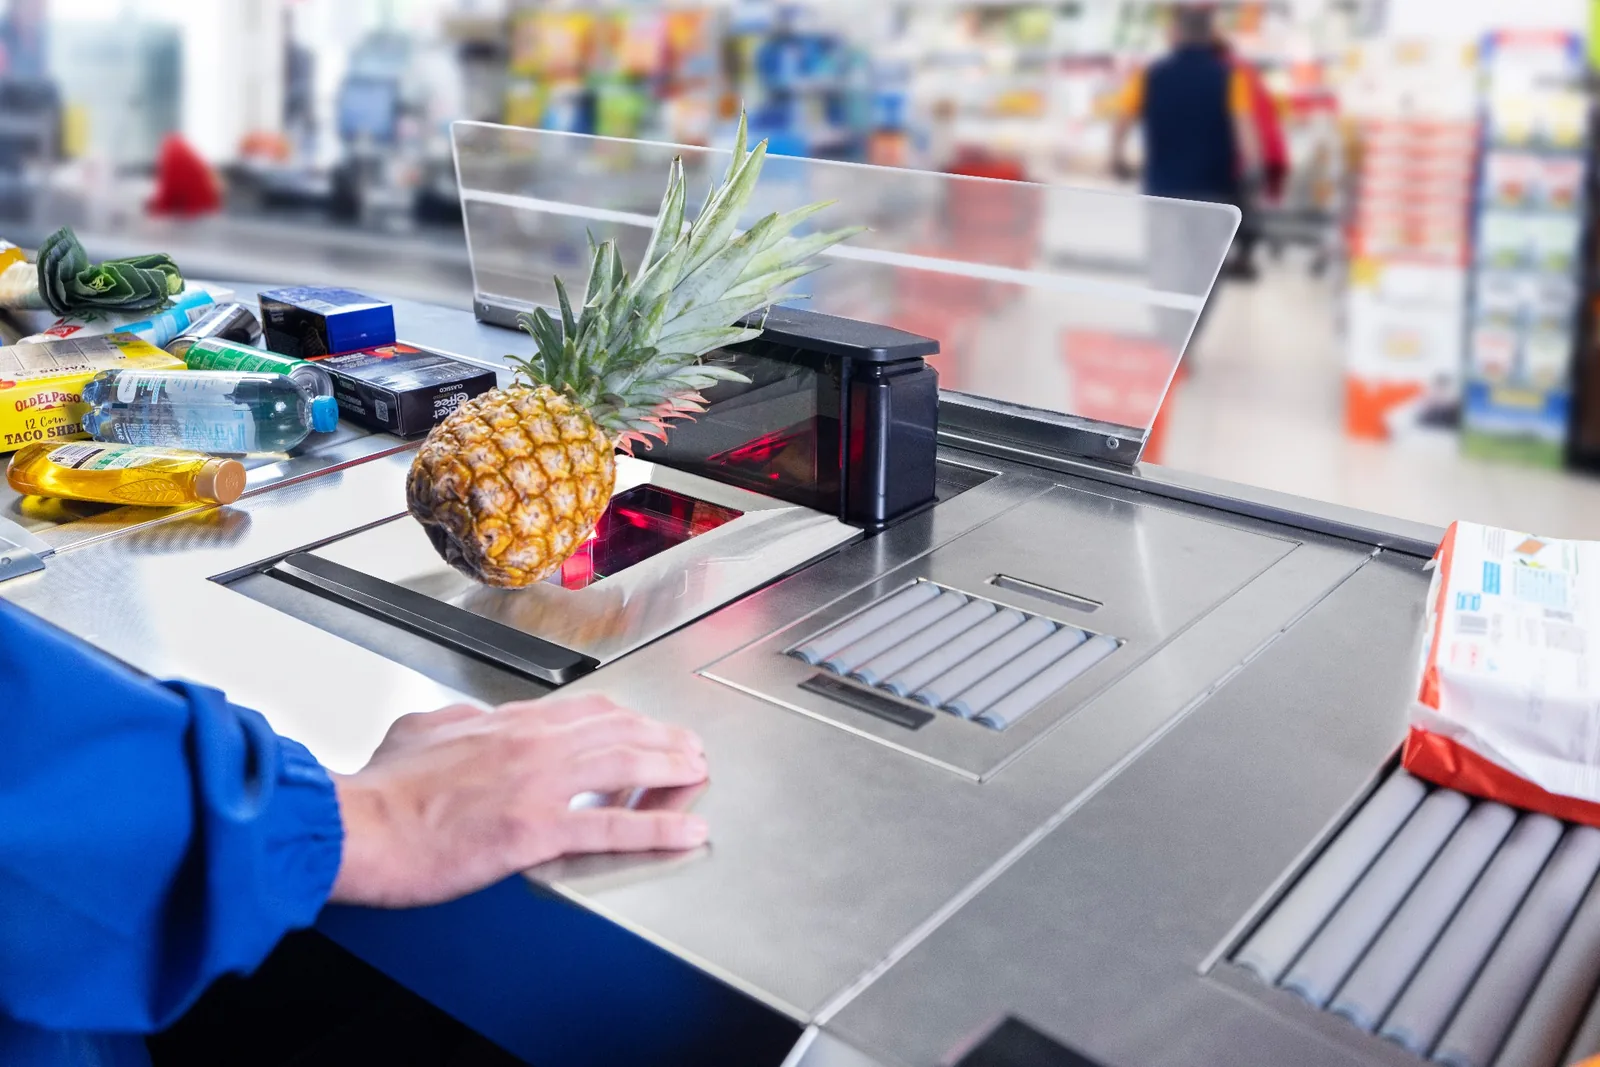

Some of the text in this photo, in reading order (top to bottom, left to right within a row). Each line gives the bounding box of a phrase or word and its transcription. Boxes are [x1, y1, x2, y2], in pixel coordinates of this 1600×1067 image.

[439, 383, 464, 393] CLASSICO
[15, 397, 37, 413] OLD
[433, 392, 469, 408] Coffee
[432, 406, 459, 419] cket
[25, 416, 67, 430] 12 Corn
[4, 430, 43, 445] TACO
